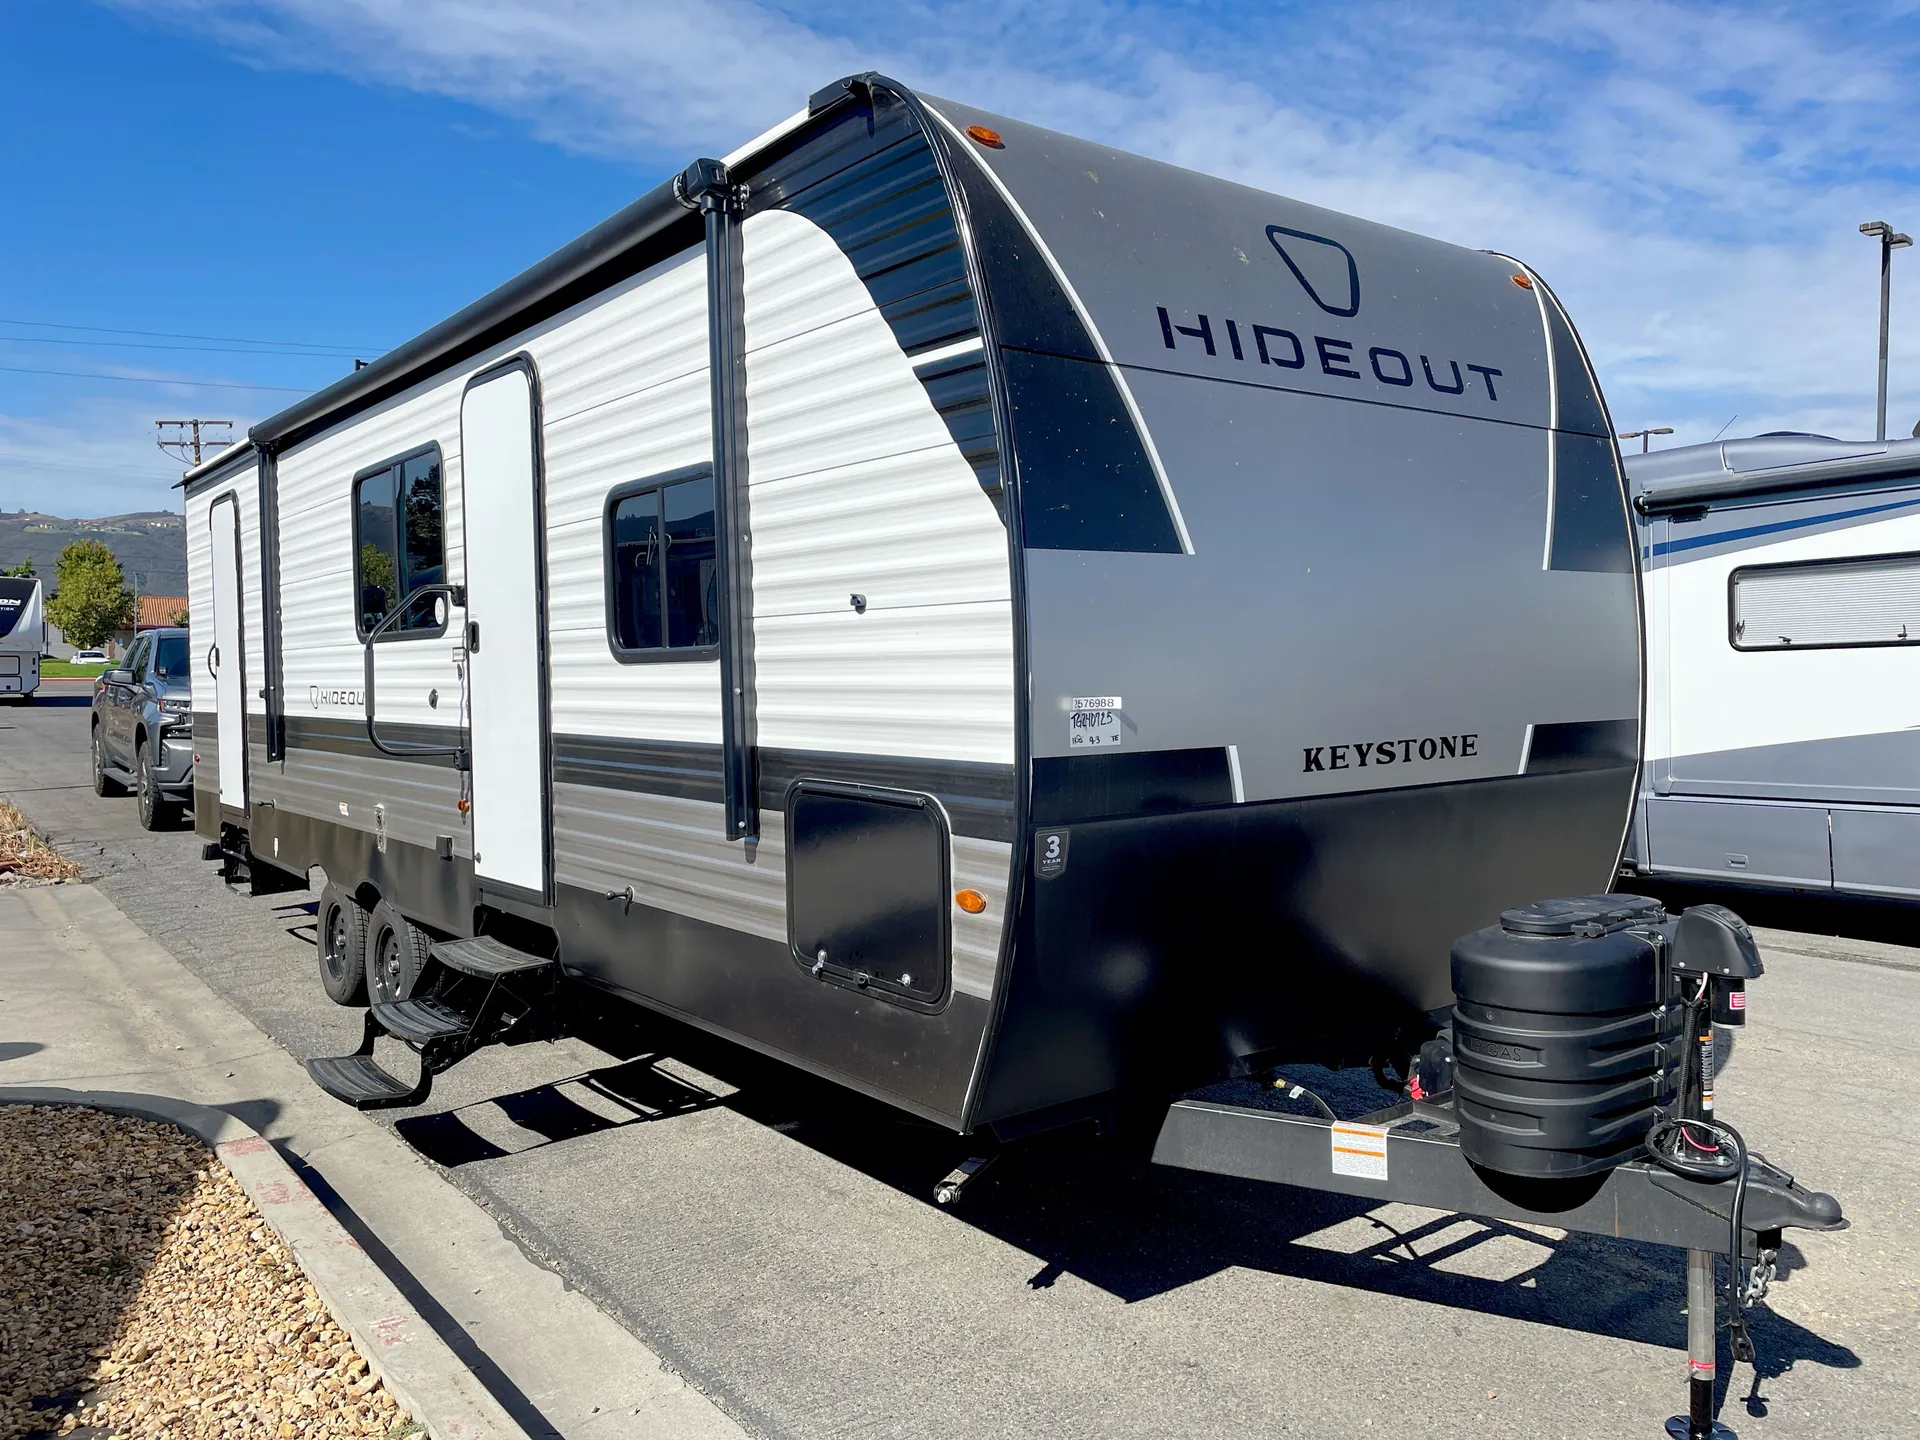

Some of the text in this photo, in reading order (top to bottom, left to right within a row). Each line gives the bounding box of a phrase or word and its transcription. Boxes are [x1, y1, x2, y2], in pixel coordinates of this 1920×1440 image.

[1156, 306, 1503, 401] HIDEOUT
[321, 691, 365, 705] HIDEOU
[1303, 733, 1479, 773] KEYSTONE
[1045, 835, 1060, 859] 3
[1487, 1042, 1522, 1062] GAS
